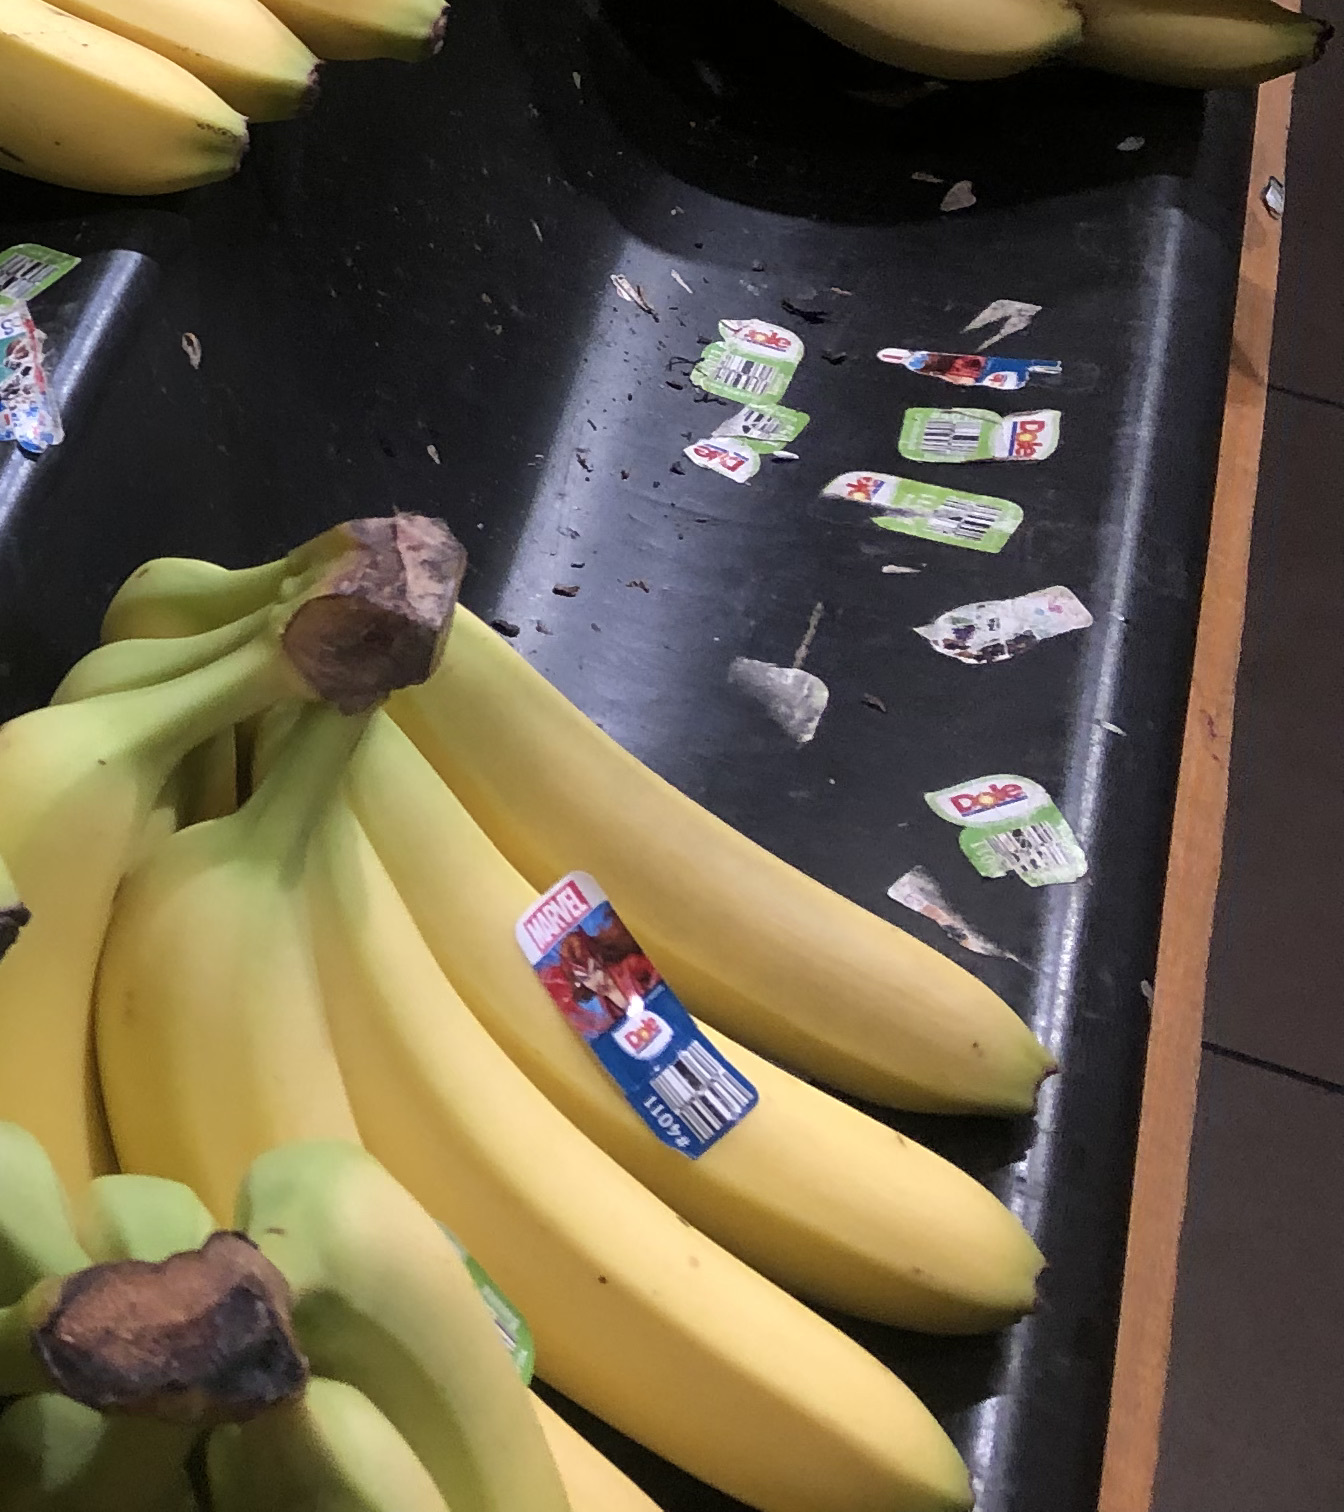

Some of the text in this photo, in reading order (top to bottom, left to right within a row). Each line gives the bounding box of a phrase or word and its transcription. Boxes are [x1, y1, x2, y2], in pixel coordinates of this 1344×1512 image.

[1015, 421, 1045, 457] Dole
[950, 784, 1024, 814] Dole
[525, 885, 587, 949] MARVEL
[625, 1016, 661, 1052] Dole
[643, 1095, 691, 1148] #4011
